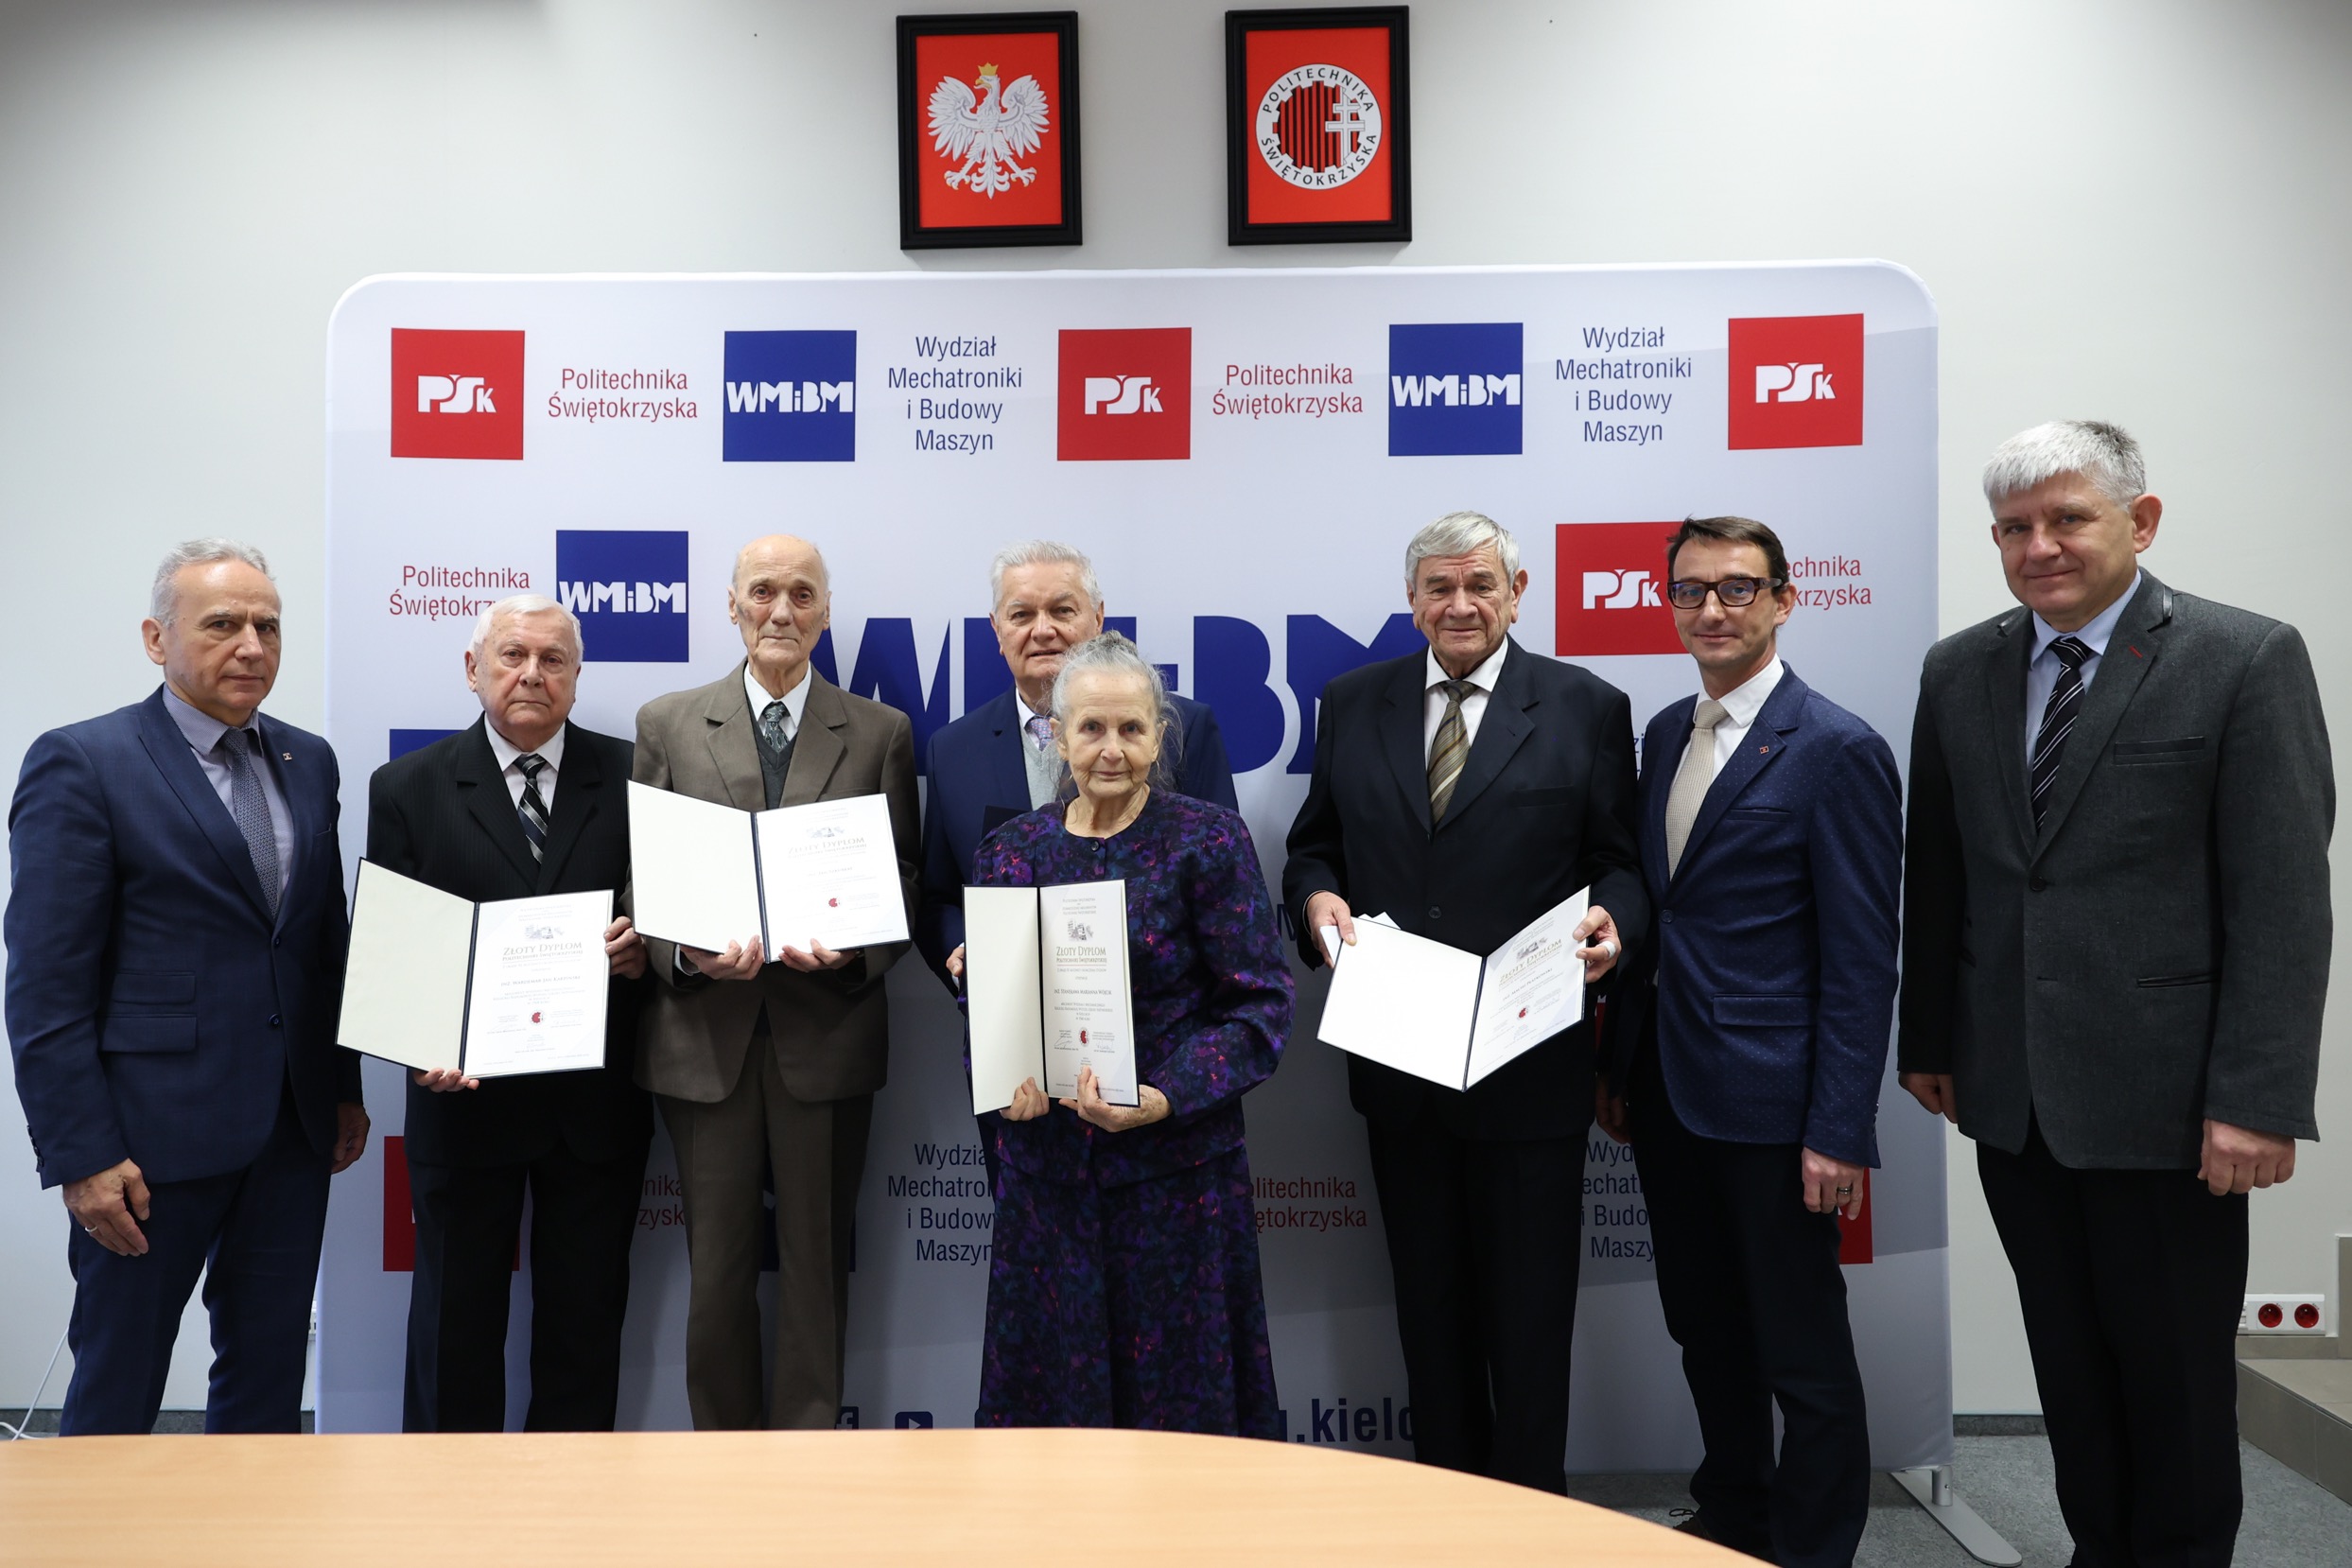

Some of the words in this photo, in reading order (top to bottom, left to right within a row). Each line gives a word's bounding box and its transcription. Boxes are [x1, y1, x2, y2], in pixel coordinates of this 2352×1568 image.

[1263, 67, 1374, 113] POLITECHNIKA
[1262, 134, 1377, 186] ŚWIĘTOKRZYSKA
[915, 335, 997, 359] Wydział
[1582, 326, 1665, 353] Wydział
[562, 368, 688, 391] Politechnika
[888, 366, 1022, 389] Mechatroniki
[1226, 362, 1353, 387] Politechnika
[1556, 357, 1692, 380] Mechatroniki
[726, 381, 853, 413] WMiBM
[1391, 374, 1521, 408] WMiBM
[1575, 391, 1580, 411] i
[1588, 389, 1673, 414] Budowy
[548, 392, 698, 424] Świętokrzyska
[906, 398, 912, 420] i
[920, 398, 1003, 425] Budowy
[1213, 389, 1363, 419] Świętokrzyska
[915, 429, 994, 455] Maszyn
[1584, 420, 1664, 446] Maszyn
[403, 565, 531, 589] Politechnika
[559, 581, 687, 614] WMiBM
[539, 942, 583, 951] DYPLOM
[1056, 947, 1077, 956] ZŁOTY
[1078, 946, 1106, 956] DYPLOM
[1526, 939, 1562, 964] DYPLOM
[915, 1142, 986, 1171] Wydzia
[888, 1175, 991, 1197] Mechatro
[1251, 1176, 1356, 1199] litechnika
[907, 1208, 912, 1229] i
[920, 1207, 996, 1229] Budow
[1255, 1206, 1368, 1234] ętokrzyska
[1594, 1204, 1648, 1227] Budo
[1591, 1236, 1654, 1263] Maszy
